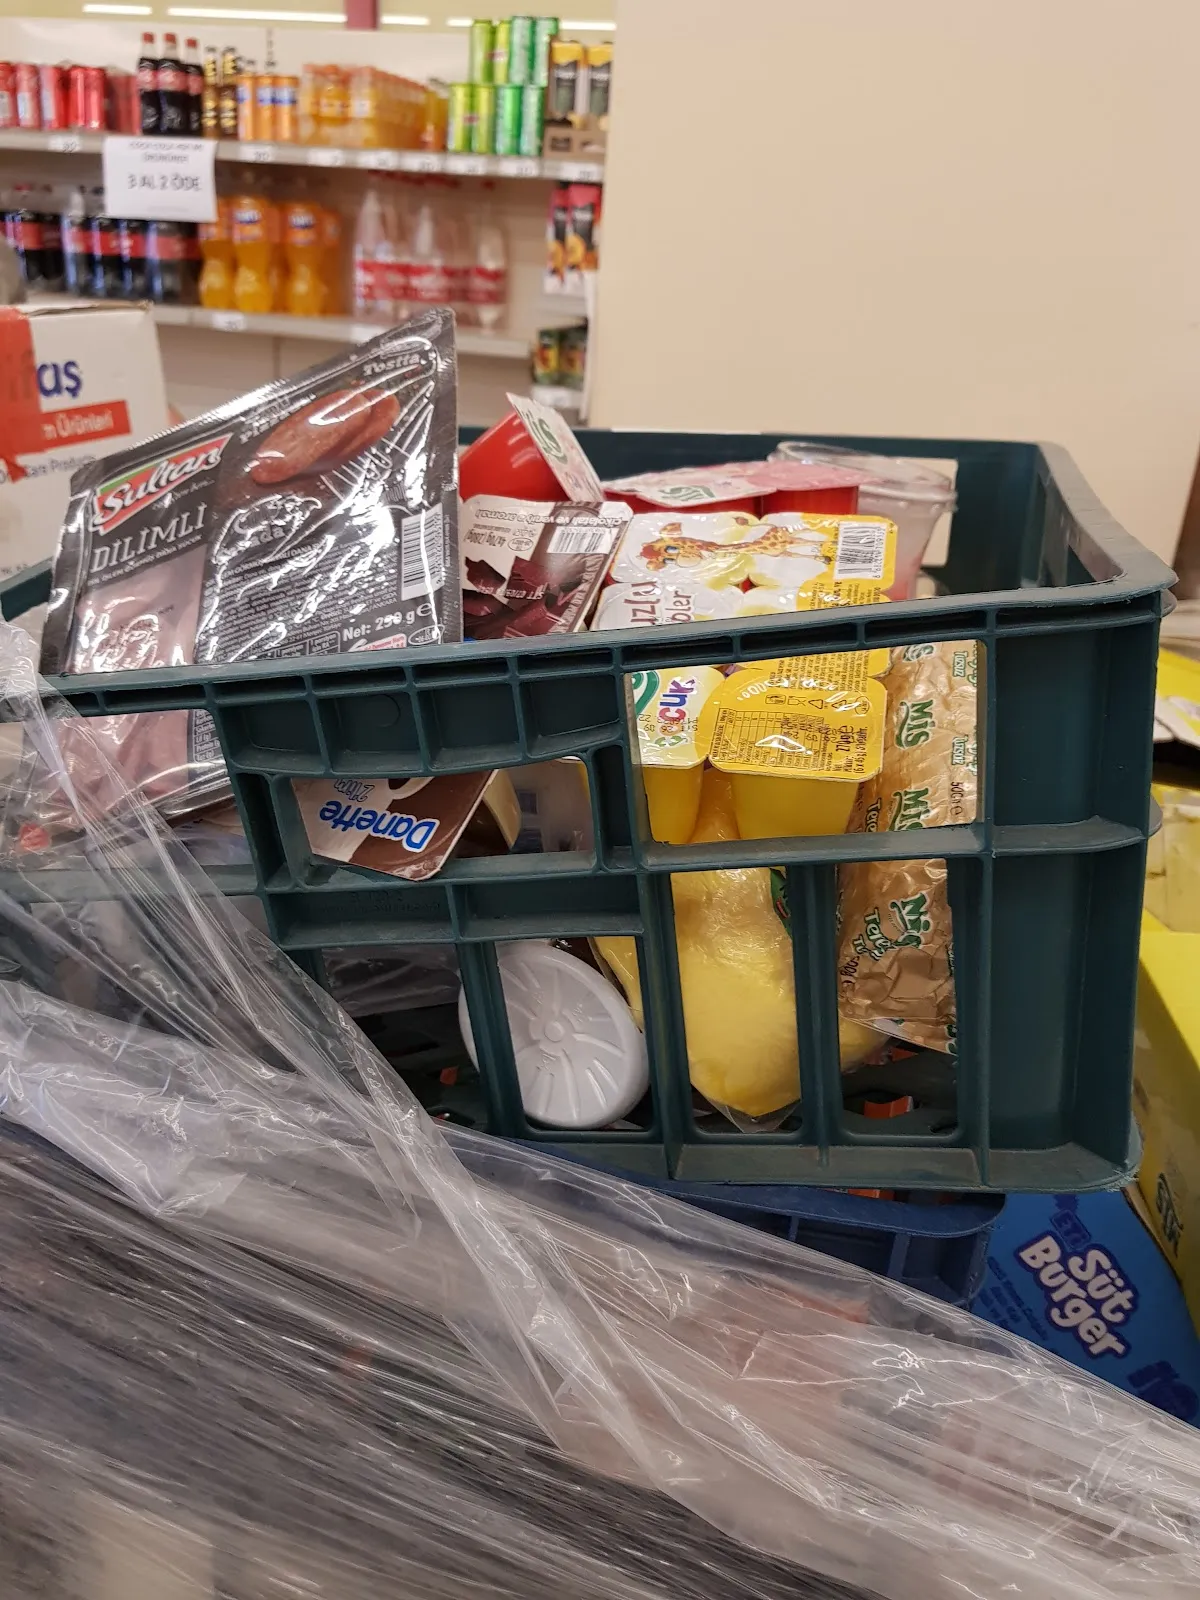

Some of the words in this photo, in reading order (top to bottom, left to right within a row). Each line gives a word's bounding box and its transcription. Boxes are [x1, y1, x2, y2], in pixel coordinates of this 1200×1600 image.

[127, 174, 138, 190] 3
[92, 447, 221, 526] Sultan
[343, 624, 372, 642] Net:
[319, 800, 437, 851] Danette
[1018, 1234, 1127, 1356] Burger
[1067, 1248, 1135, 1324] Süt
